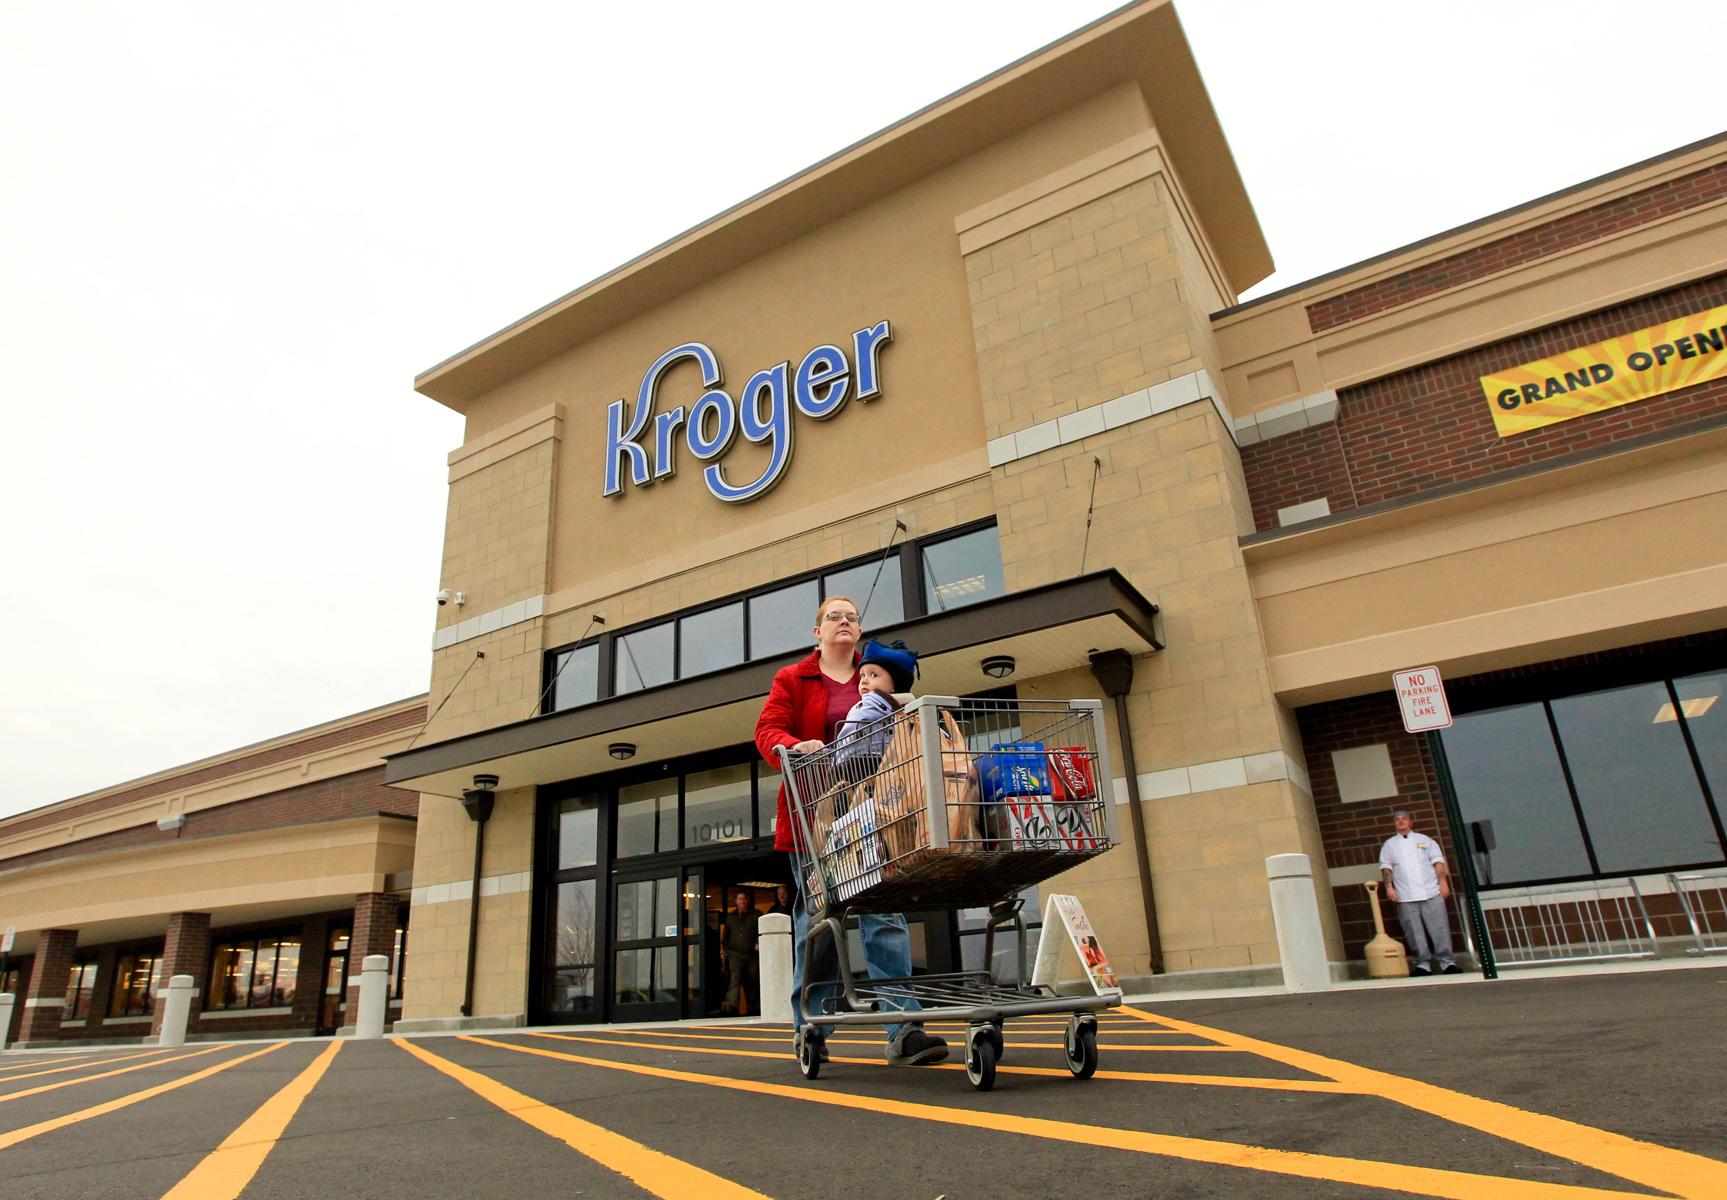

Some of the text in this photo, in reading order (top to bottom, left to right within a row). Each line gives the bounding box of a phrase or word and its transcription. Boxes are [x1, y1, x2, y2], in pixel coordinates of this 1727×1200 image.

[1497, 363, 1614, 411] GRAND
[603, 319, 893, 502] Kroger
[1408, 674, 1425, 686] NO
[1401, 685, 1439, 697] PARKING
[1412, 696, 1432, 706] FIRE
[1413, 706, 1437, 717] LANE
[692, 818, 743, 844] 10101
